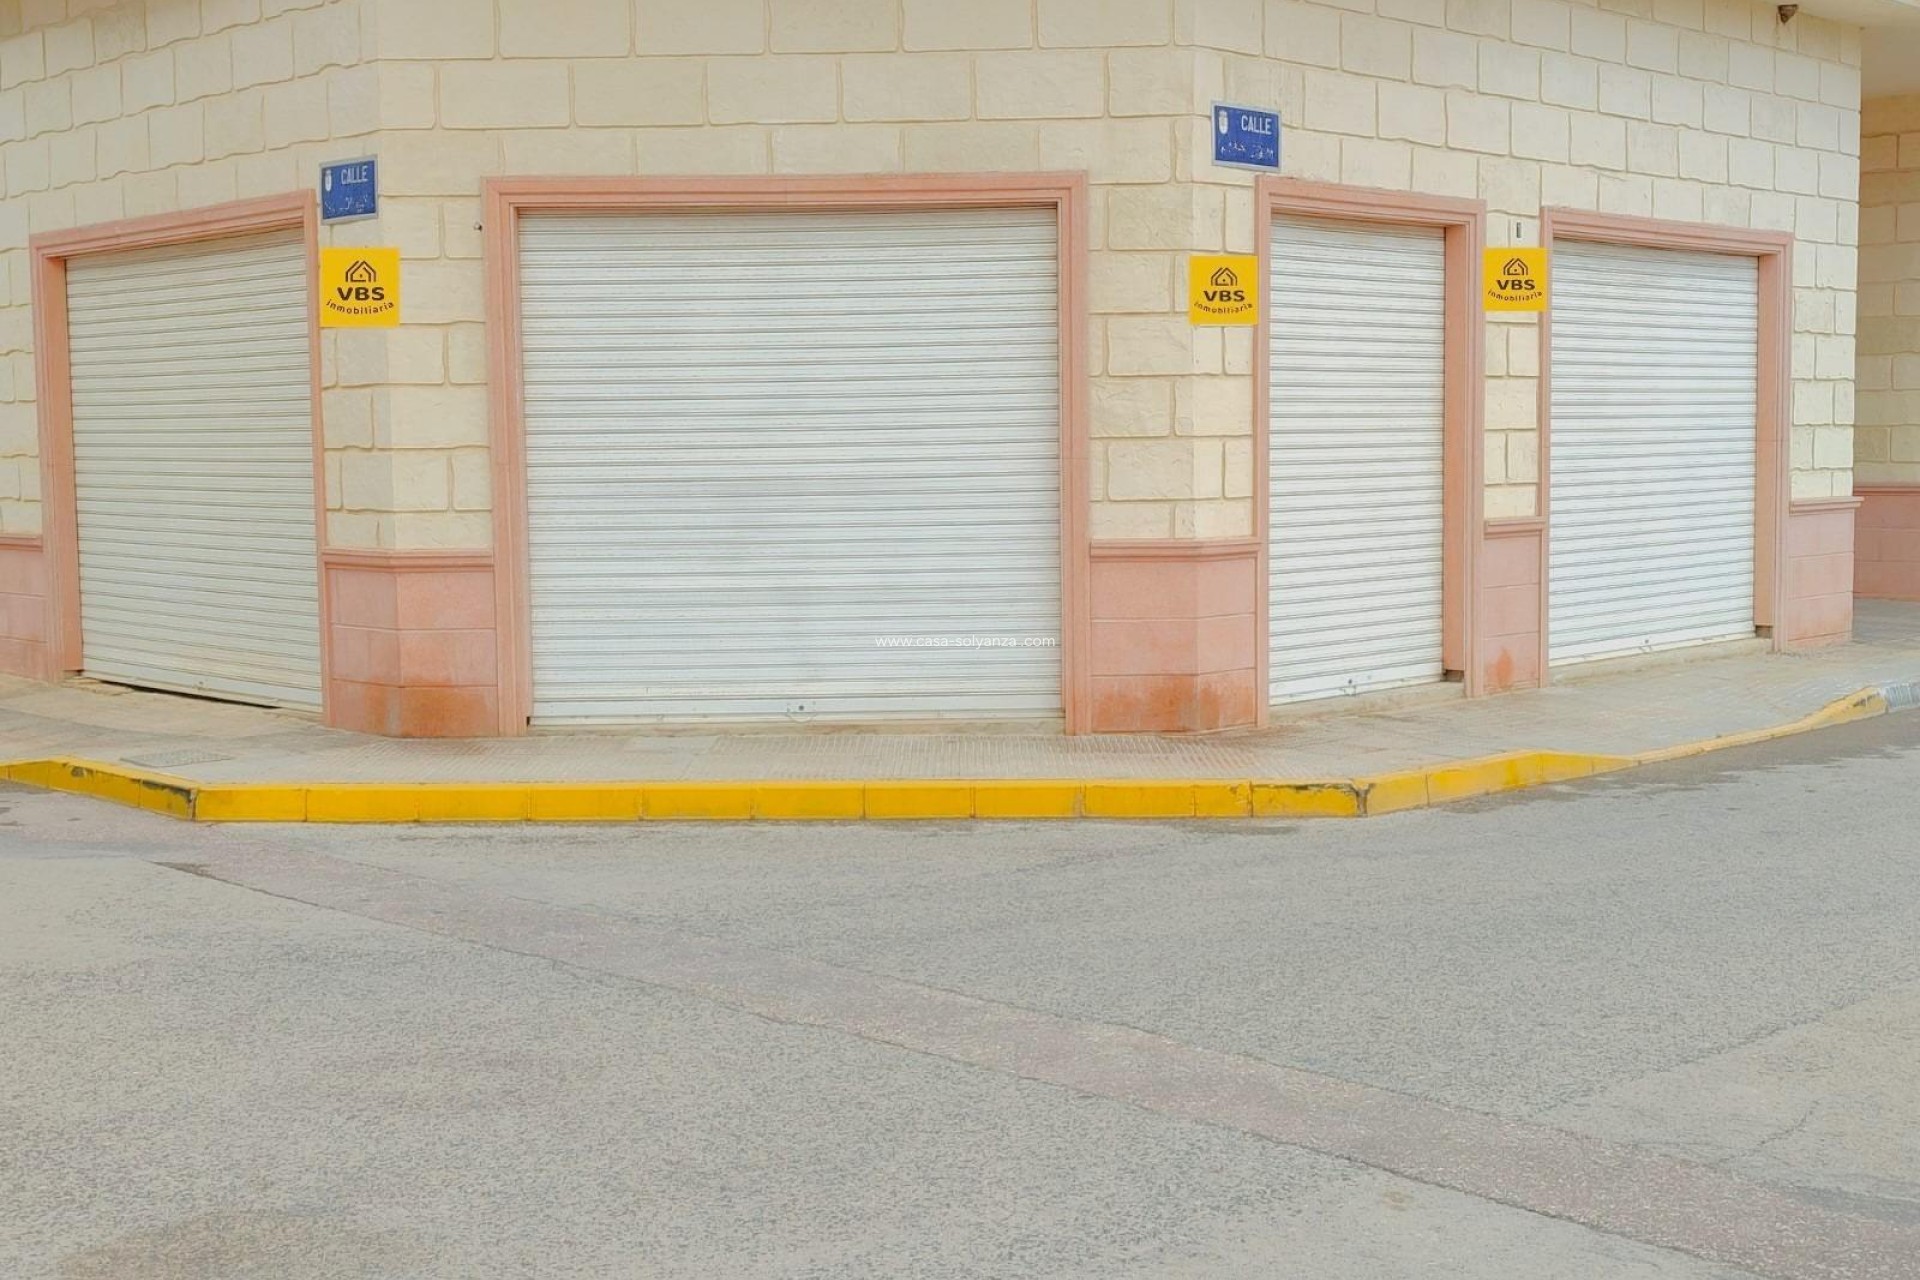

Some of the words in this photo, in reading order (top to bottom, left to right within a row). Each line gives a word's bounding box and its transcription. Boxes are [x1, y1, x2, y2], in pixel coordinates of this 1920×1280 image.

[1241, 114, 1273, 136] CALLE
[340, 165, 369, 185] CALLE
[1495, 279, 1536, 291] VBS
[336, 286, 385, 301] VBS
[1203, 290, 1246, 303] VBS
[1487, 289, 1543, 302] inmobiliaria
[325, 298, 395, 315] inmobiliaria
[1193, 301, 1254, 315] inmobiliaria
